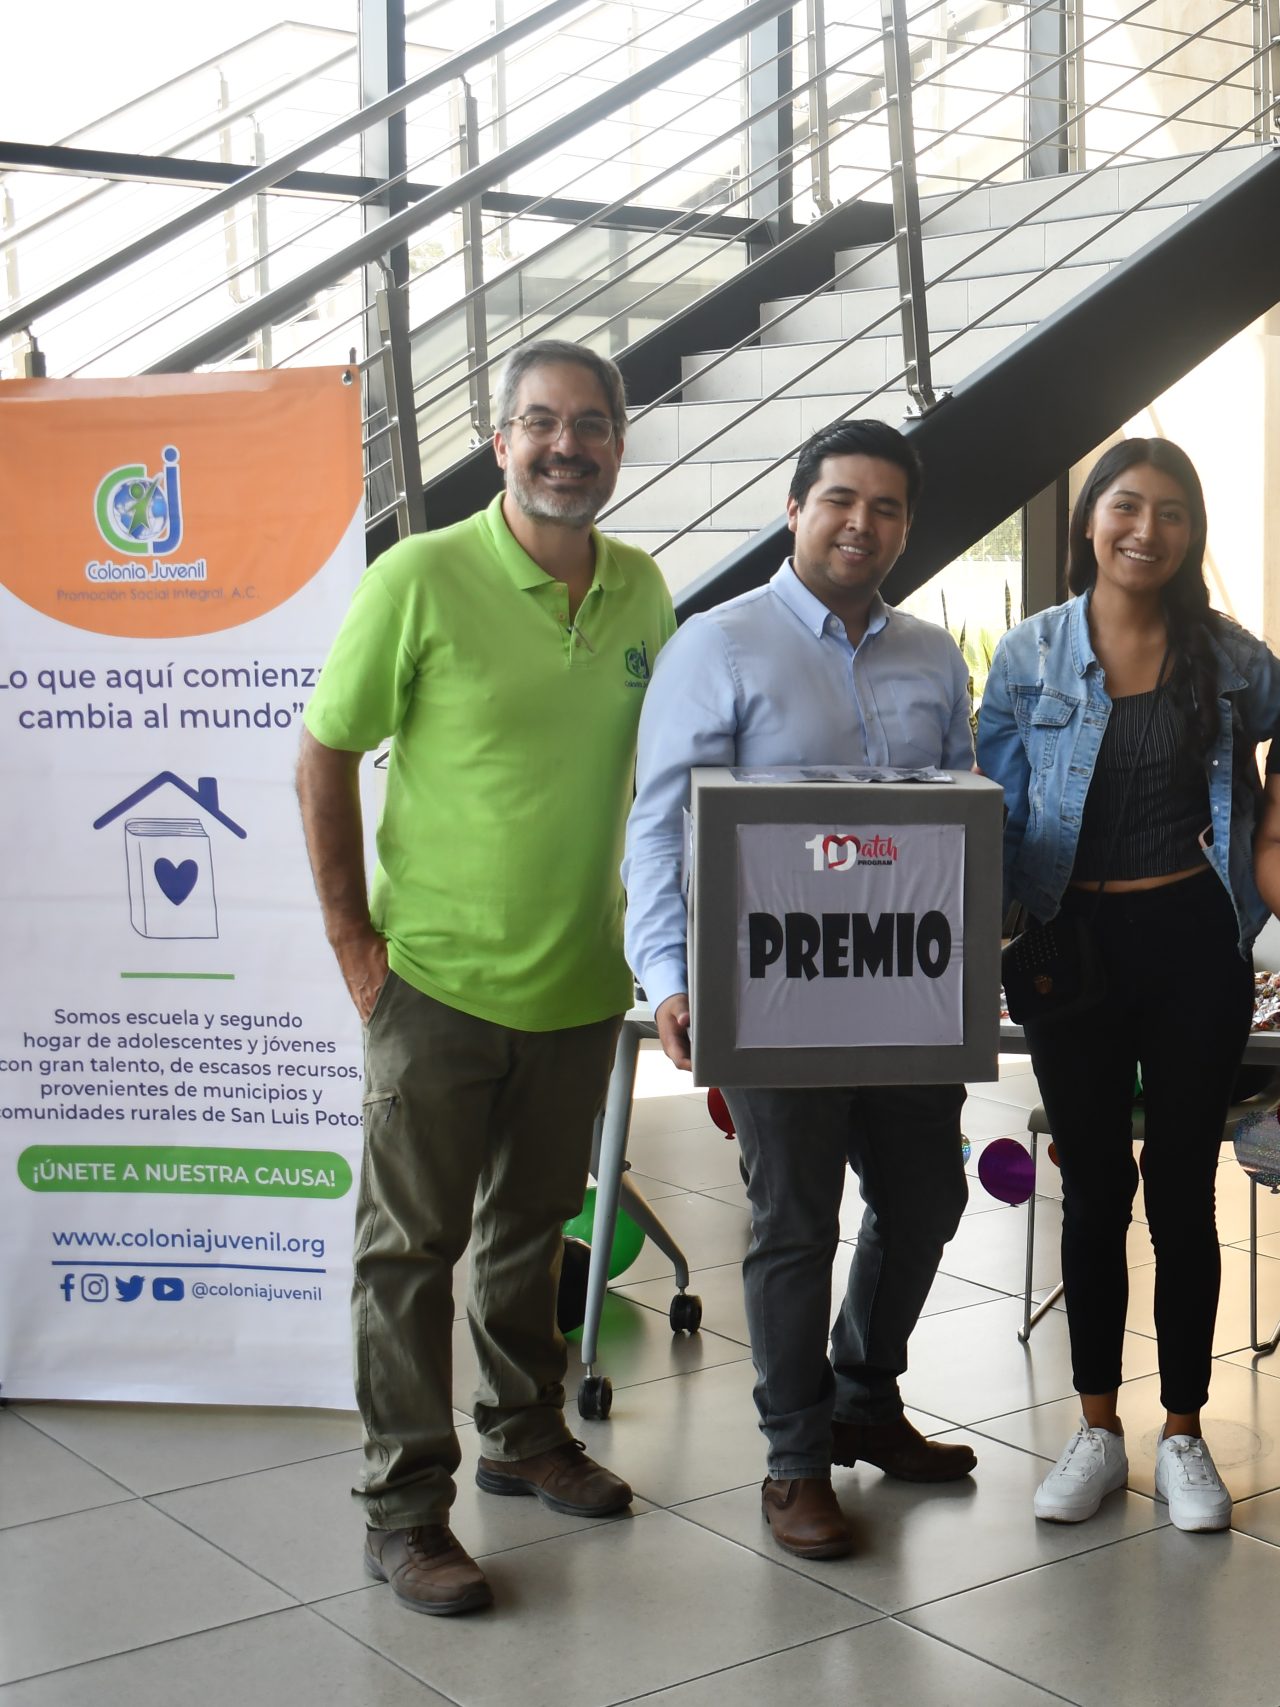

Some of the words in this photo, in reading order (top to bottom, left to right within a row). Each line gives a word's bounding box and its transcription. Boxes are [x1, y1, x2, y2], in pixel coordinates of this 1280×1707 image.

[88, 563, 146, 580] Colonia
[151, 560, 205, 579] Juvenil
[57, 588, 126, 601] Promoción
[131, 588, 169, 600] Social
[231, 586, 260, 598] A.C.
[37, 669, 96, 695] que
[106, 662, 174, 695] aquí
[183, 661, 323, 688] comienz
[19, 702, 133, 729] cambia
[144, 702, 168, 729] al
[748, 910, 951, 981] PREMIO
[54, 1008, 121, 1025] Somos
[126, 1009, 199, 1026] escuela
[204, 1013, 215, 1029] y
[220, 1011, 303, 1031] segundo
[23, 1032, 81, 1051] hogar
[87, 1033, 112, 1049] de
[117, 1033, 242, 1050] adolescentes
[247, 1037, 258, 1054] y
[262, 1034, 337, 1054] jóvenes
[39, 1060, 84, 1076] gran
[90, 1057, 165, 1076] talento,
[170, 1057, 194, 1074] de
[199, 1060, 272, 1077] escasos
[277, 1061, 362, 1081] recursos,
[41, 1081, 169, 1100] provenientes
[174, 1081, 198, 1098] de
[203, 1082, 308, 1103] municipios
[312, 1088, 323, 1105] y
[0, 1104, 125, 1121] omunidades
[131, 1105, 197, 1122] rurales
[202, 1106, 226, 1123] de
[231, 1107, 265, 1124] San
[271, 1108, 310, 1125] Luis
[33, 1158, 116, 1184] ¡ÚNETE
[123, 1164, 139, 1181] A
[145, 1164, 249, 1184] NUESTRA
[254, 1167, 336, 1188] CAUSA!
[52, 1228, 325, 1258] www.coloniajuvenil.org
[192, 1282, 322, 1301] @coloniajuvenil
